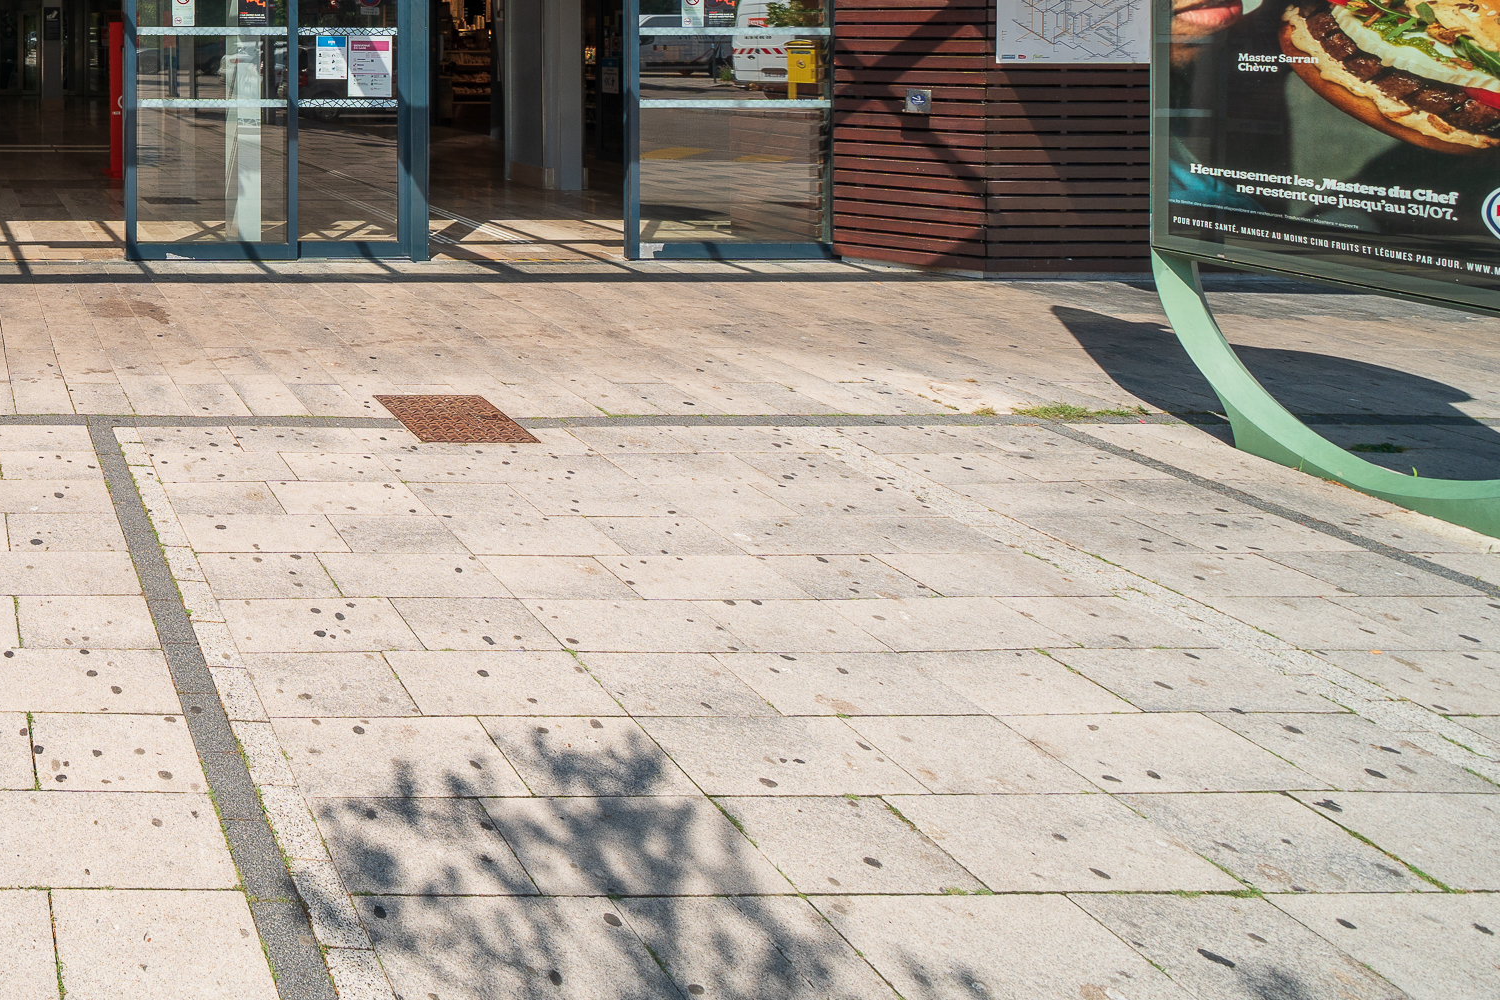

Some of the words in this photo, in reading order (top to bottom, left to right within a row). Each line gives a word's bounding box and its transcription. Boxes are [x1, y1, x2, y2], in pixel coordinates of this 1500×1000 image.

[1237, 53, 1278, 63] Master
[1278, 54, 1319, 64] Sarran
[1237, 63, 1278, 72] Chèvre
[1190, 163, 1292, 186] Heureusement
[1293, 175, 1315, 188] les
[1314, 178, 1387, 197] Masters
[1388, 186, 1411, 200] du
[1412, 189, 1460, 205] Chef
[1224, 205, 1249, 213] disponibles
[1284, 214, 1310, 222] Traduction
[1236, 183, 1254, 194] ne
[1255, 186, 1308, 201] restent
[1308, 193, 1337, 206] que
[1337, 194, 1406, 214] jusqu’au
[1407, 203, 1459, 221] 31/07.
[1173, 216, 1190, 226] POUR
[1192, 219, 1213, 229] VOTRE
[1215, 222, 1239, 234] SANTÉ,
[1241, 227, 1270, 238] MANGEZ
[1271, 231, 1281, 239] AU
[1284, 233, 1307, 245] MOINS
[1310, 237, 1329, 248] CINQ
[1331, 241, 1359, 253] FRUITS
[1362, 245, 1371, 254] ET
[1375, 247, 1413, 262] LÉGUMES
[1416, 255, 1433, 264] PAR
[1435, 258, 1463, 270] JOUR.
